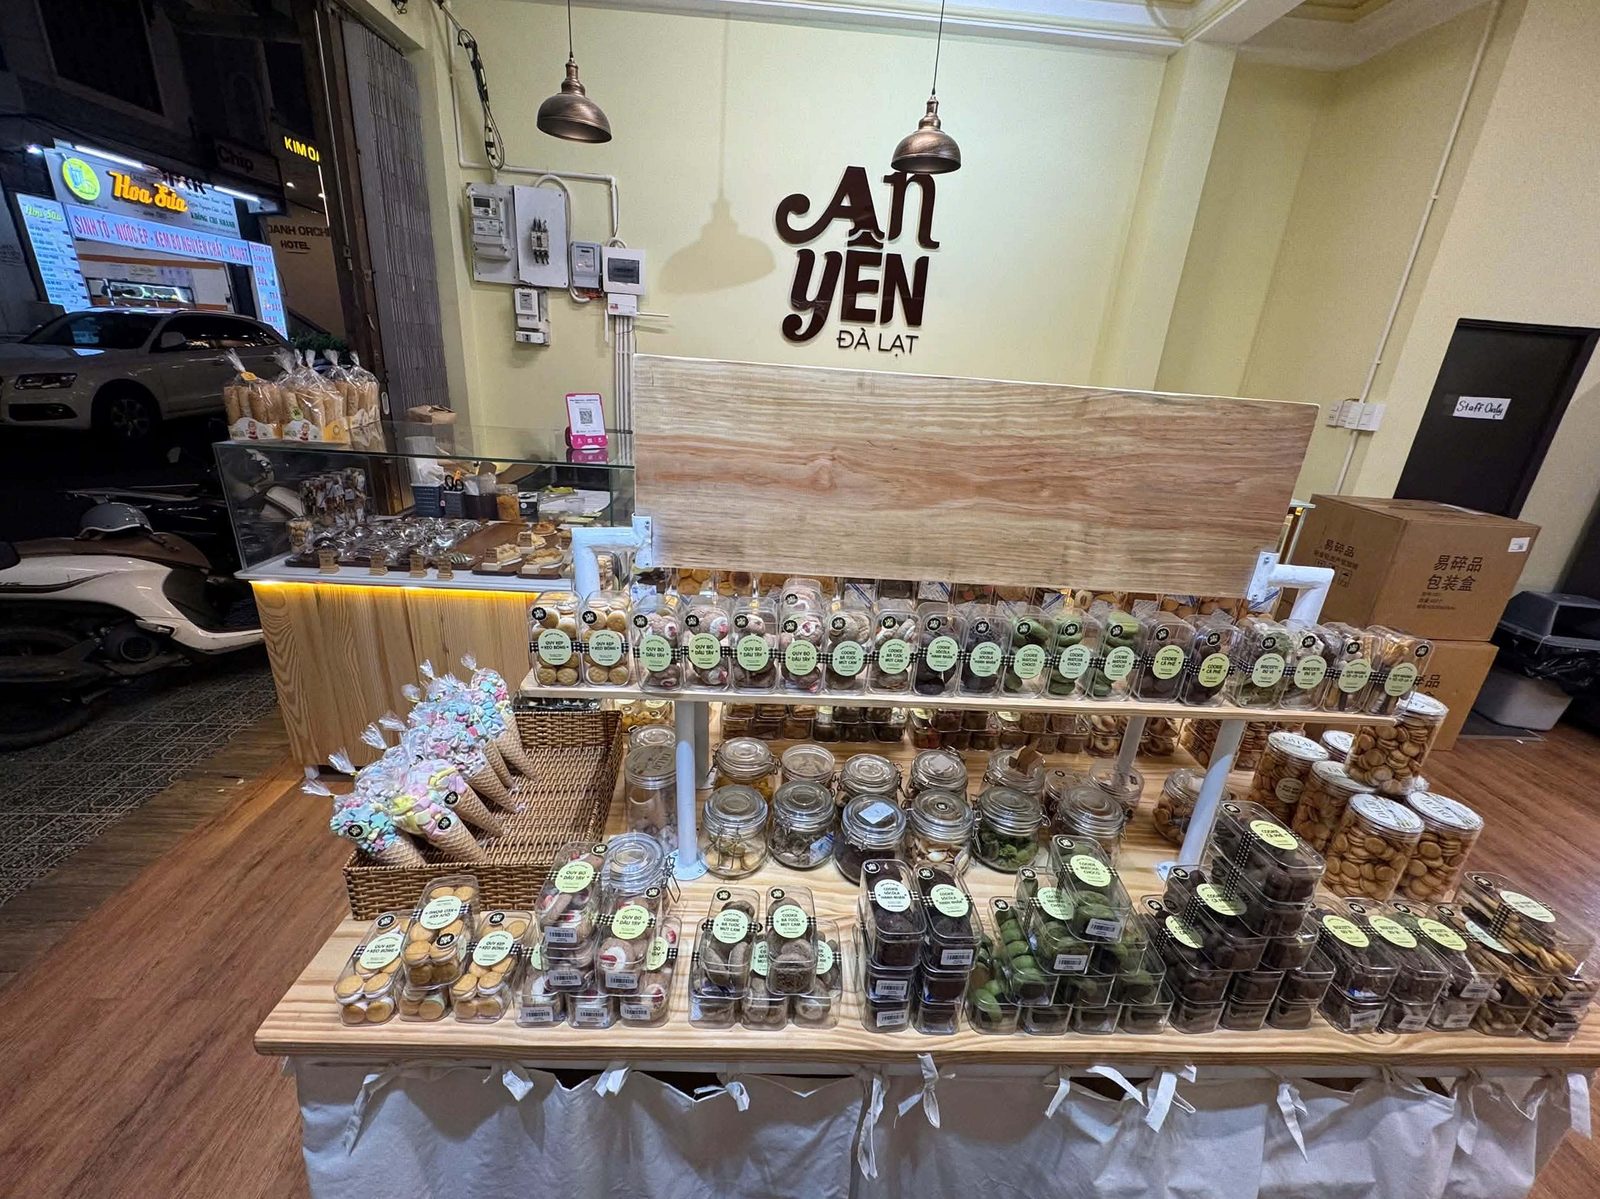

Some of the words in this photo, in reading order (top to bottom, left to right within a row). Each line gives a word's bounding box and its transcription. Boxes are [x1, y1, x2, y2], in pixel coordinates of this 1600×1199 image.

[284, 136, 307, 157] KIM
[108, 170, 153, 204] Hoa
[73, 214, 99, 236] SINH
[99, 214, 111, 239] TỐ
[154, 230, 169, 248] KEM
[280, 240, 310, 250] HOTEL
[836, 328, 870, 350] ĐÀ
[878, 333, 919, 357] LẠT
[1456, 400, 1485, 412] Staff
[1485, 402, 1503, 418] Only
[1433, 554, 1483, 572] 易碎品
[1426, 574, 1476, 592] 包装盒
